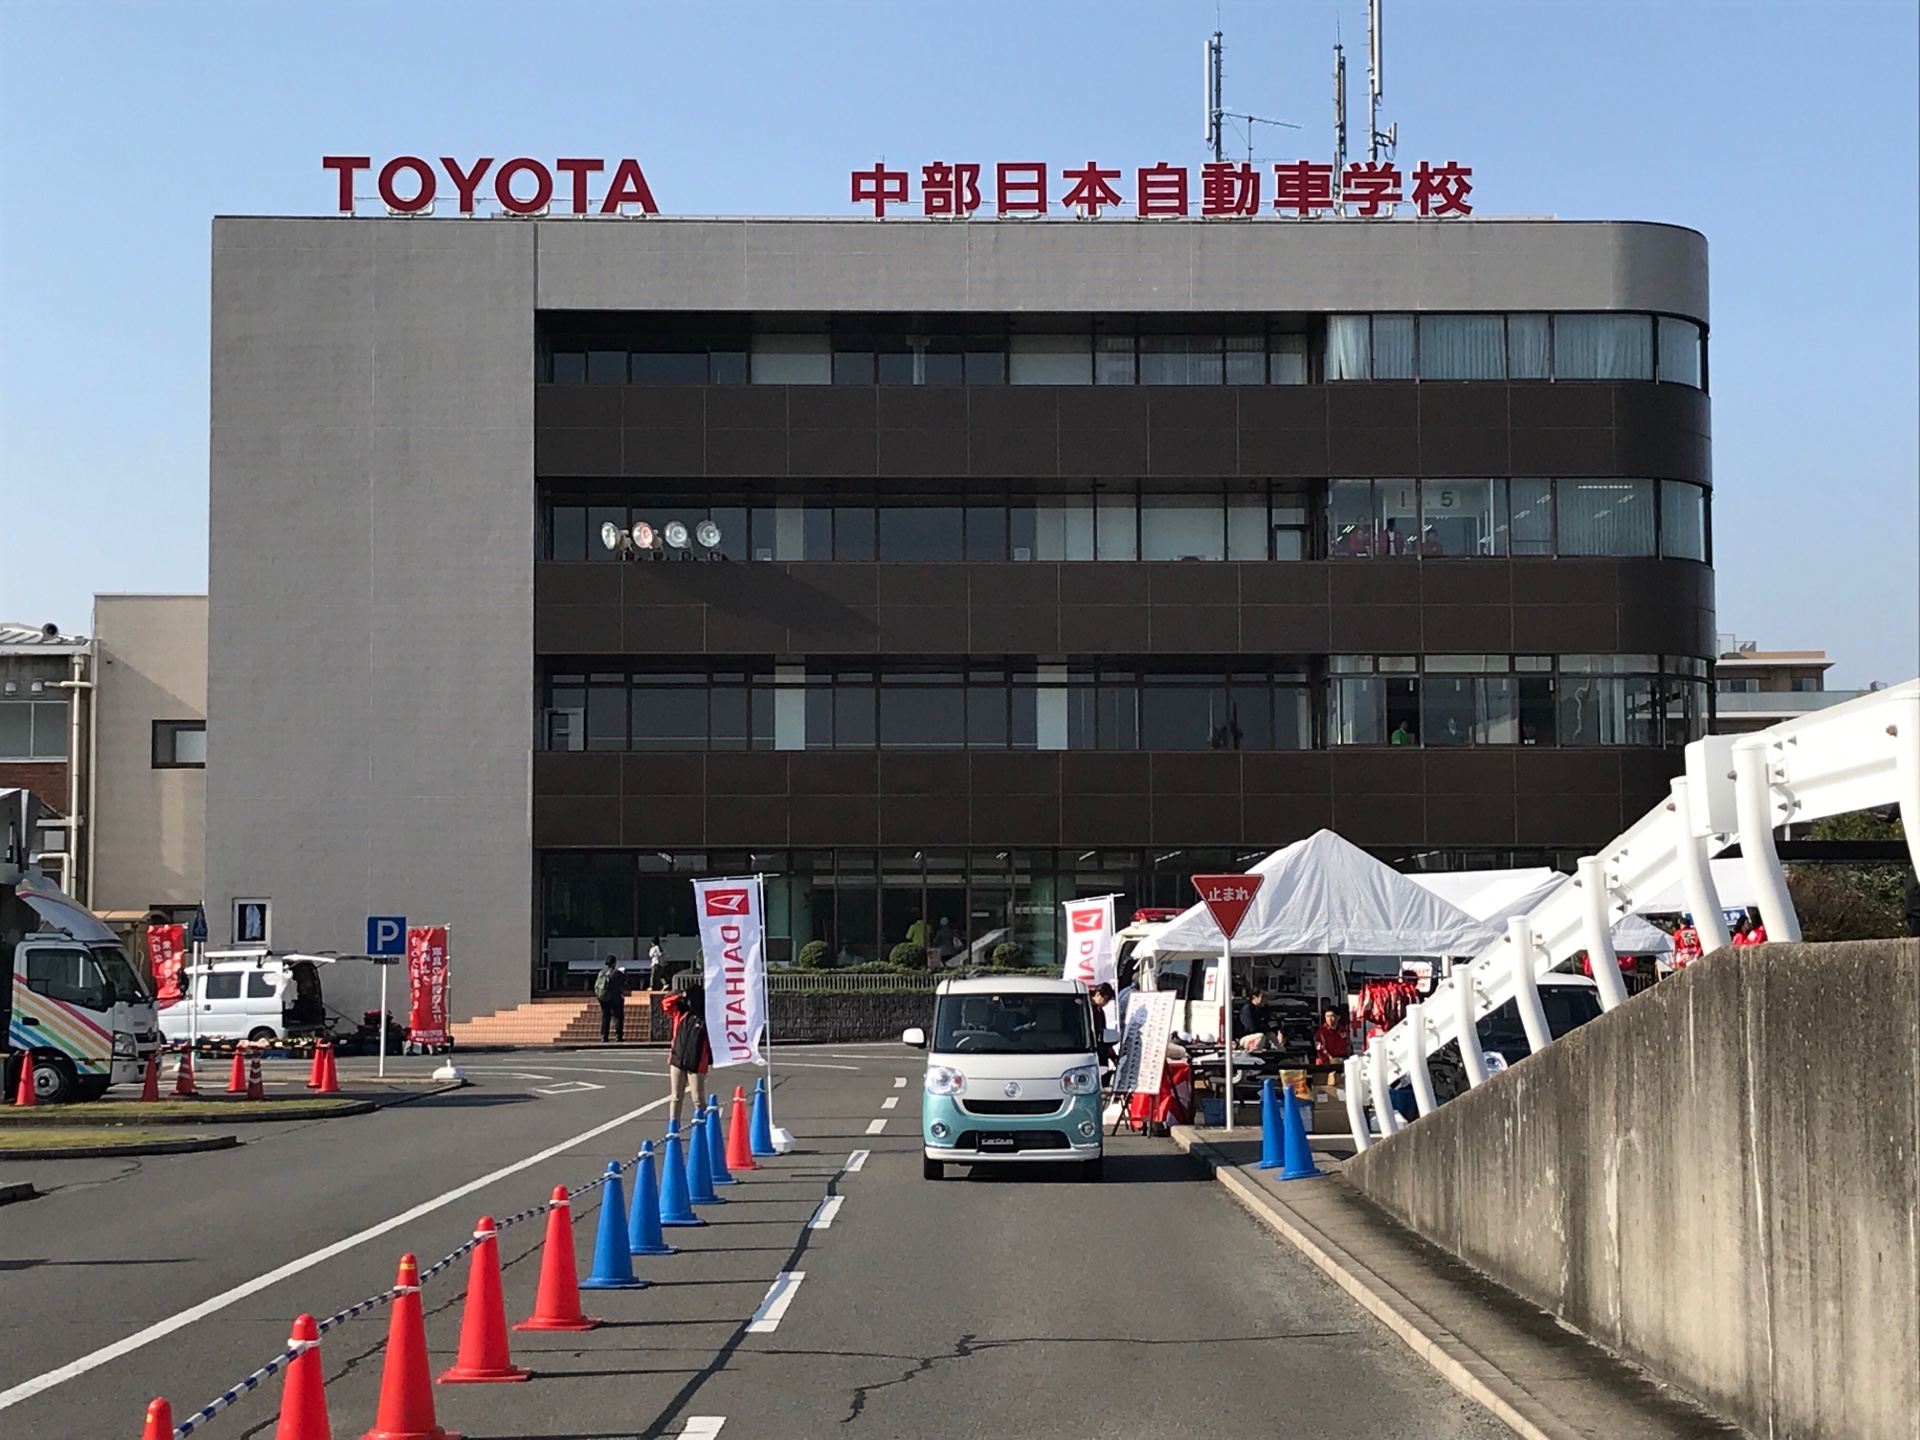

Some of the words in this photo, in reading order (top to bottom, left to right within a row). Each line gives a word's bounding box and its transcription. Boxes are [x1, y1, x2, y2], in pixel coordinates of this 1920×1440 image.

[322, 155, 661, 215] TOYOTA
[851, 160, 1474, 218] 中部日本自動車学校
[1207, 886, 1250, 902] 止まれ
[377, 919, 400, 951] P
